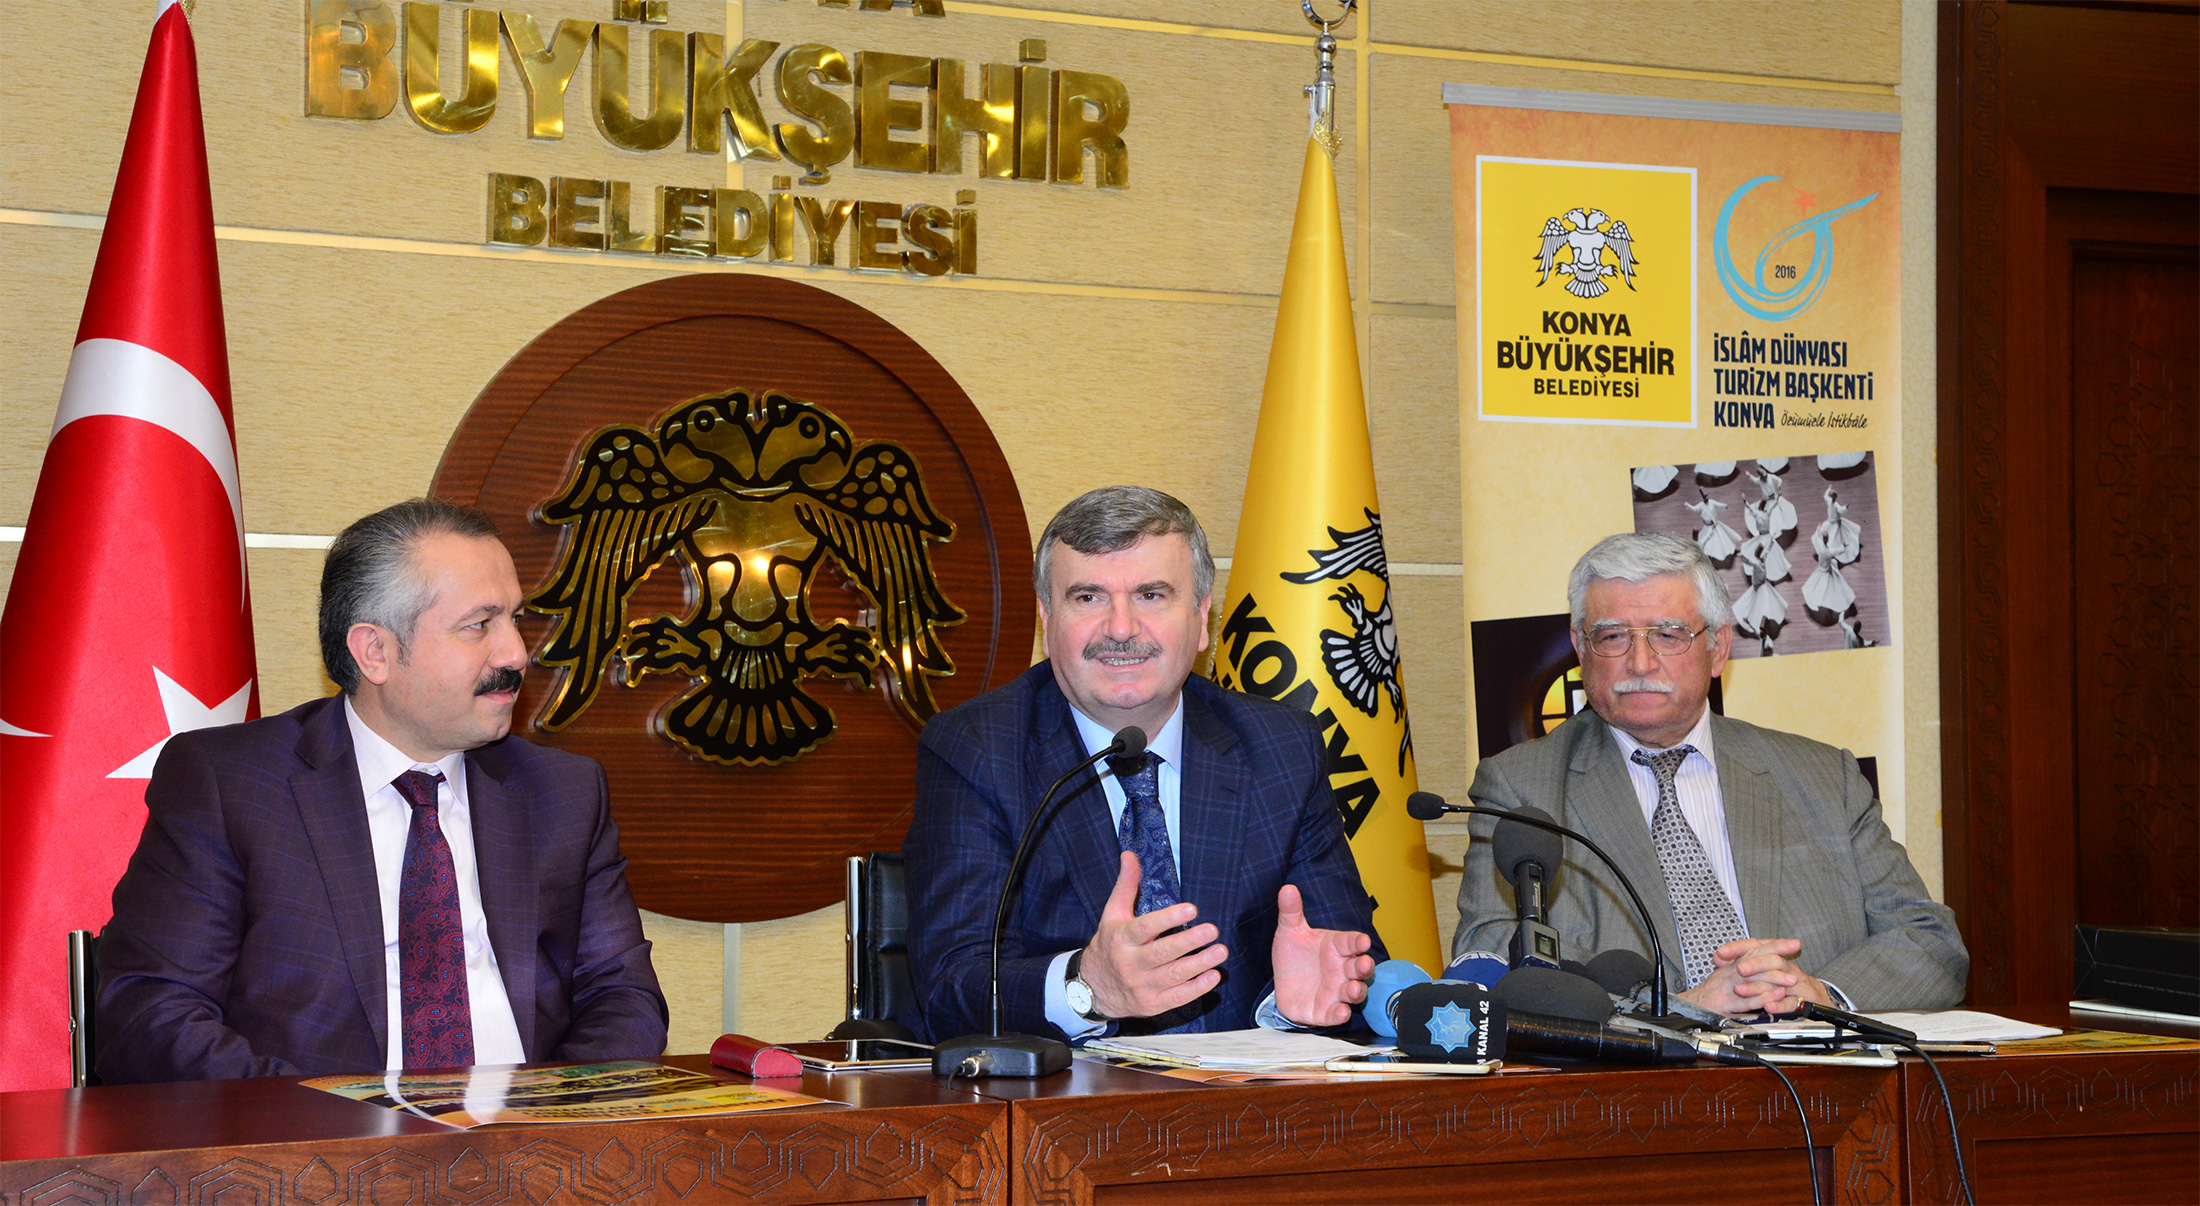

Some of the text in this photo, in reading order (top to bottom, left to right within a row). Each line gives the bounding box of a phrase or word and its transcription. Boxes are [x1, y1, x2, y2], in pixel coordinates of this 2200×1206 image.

[487, 172, 978, 277] BELEDİYESİ
[1775, 264, 1796, 279] 2016
[1542, 310, 1632, 337] KONYA
[1497, 335, 1675, 376] BÜYÜKŞEHİR
[1713, 330, 1848, 368] İSLÂM DÜNYASI
[1533, 375, 1640, 398] BELEDİYESİ
[1713, 367, 1873, 403] TURİZM BAŞKENTİ
[1713, 400, 1775, 429] KONYA
[1780, 409, 1826, 428] Özümüzle
[1479, 1000, 1490, 1015] 42
[1476, 1016, 1489, 1056] KANAL
